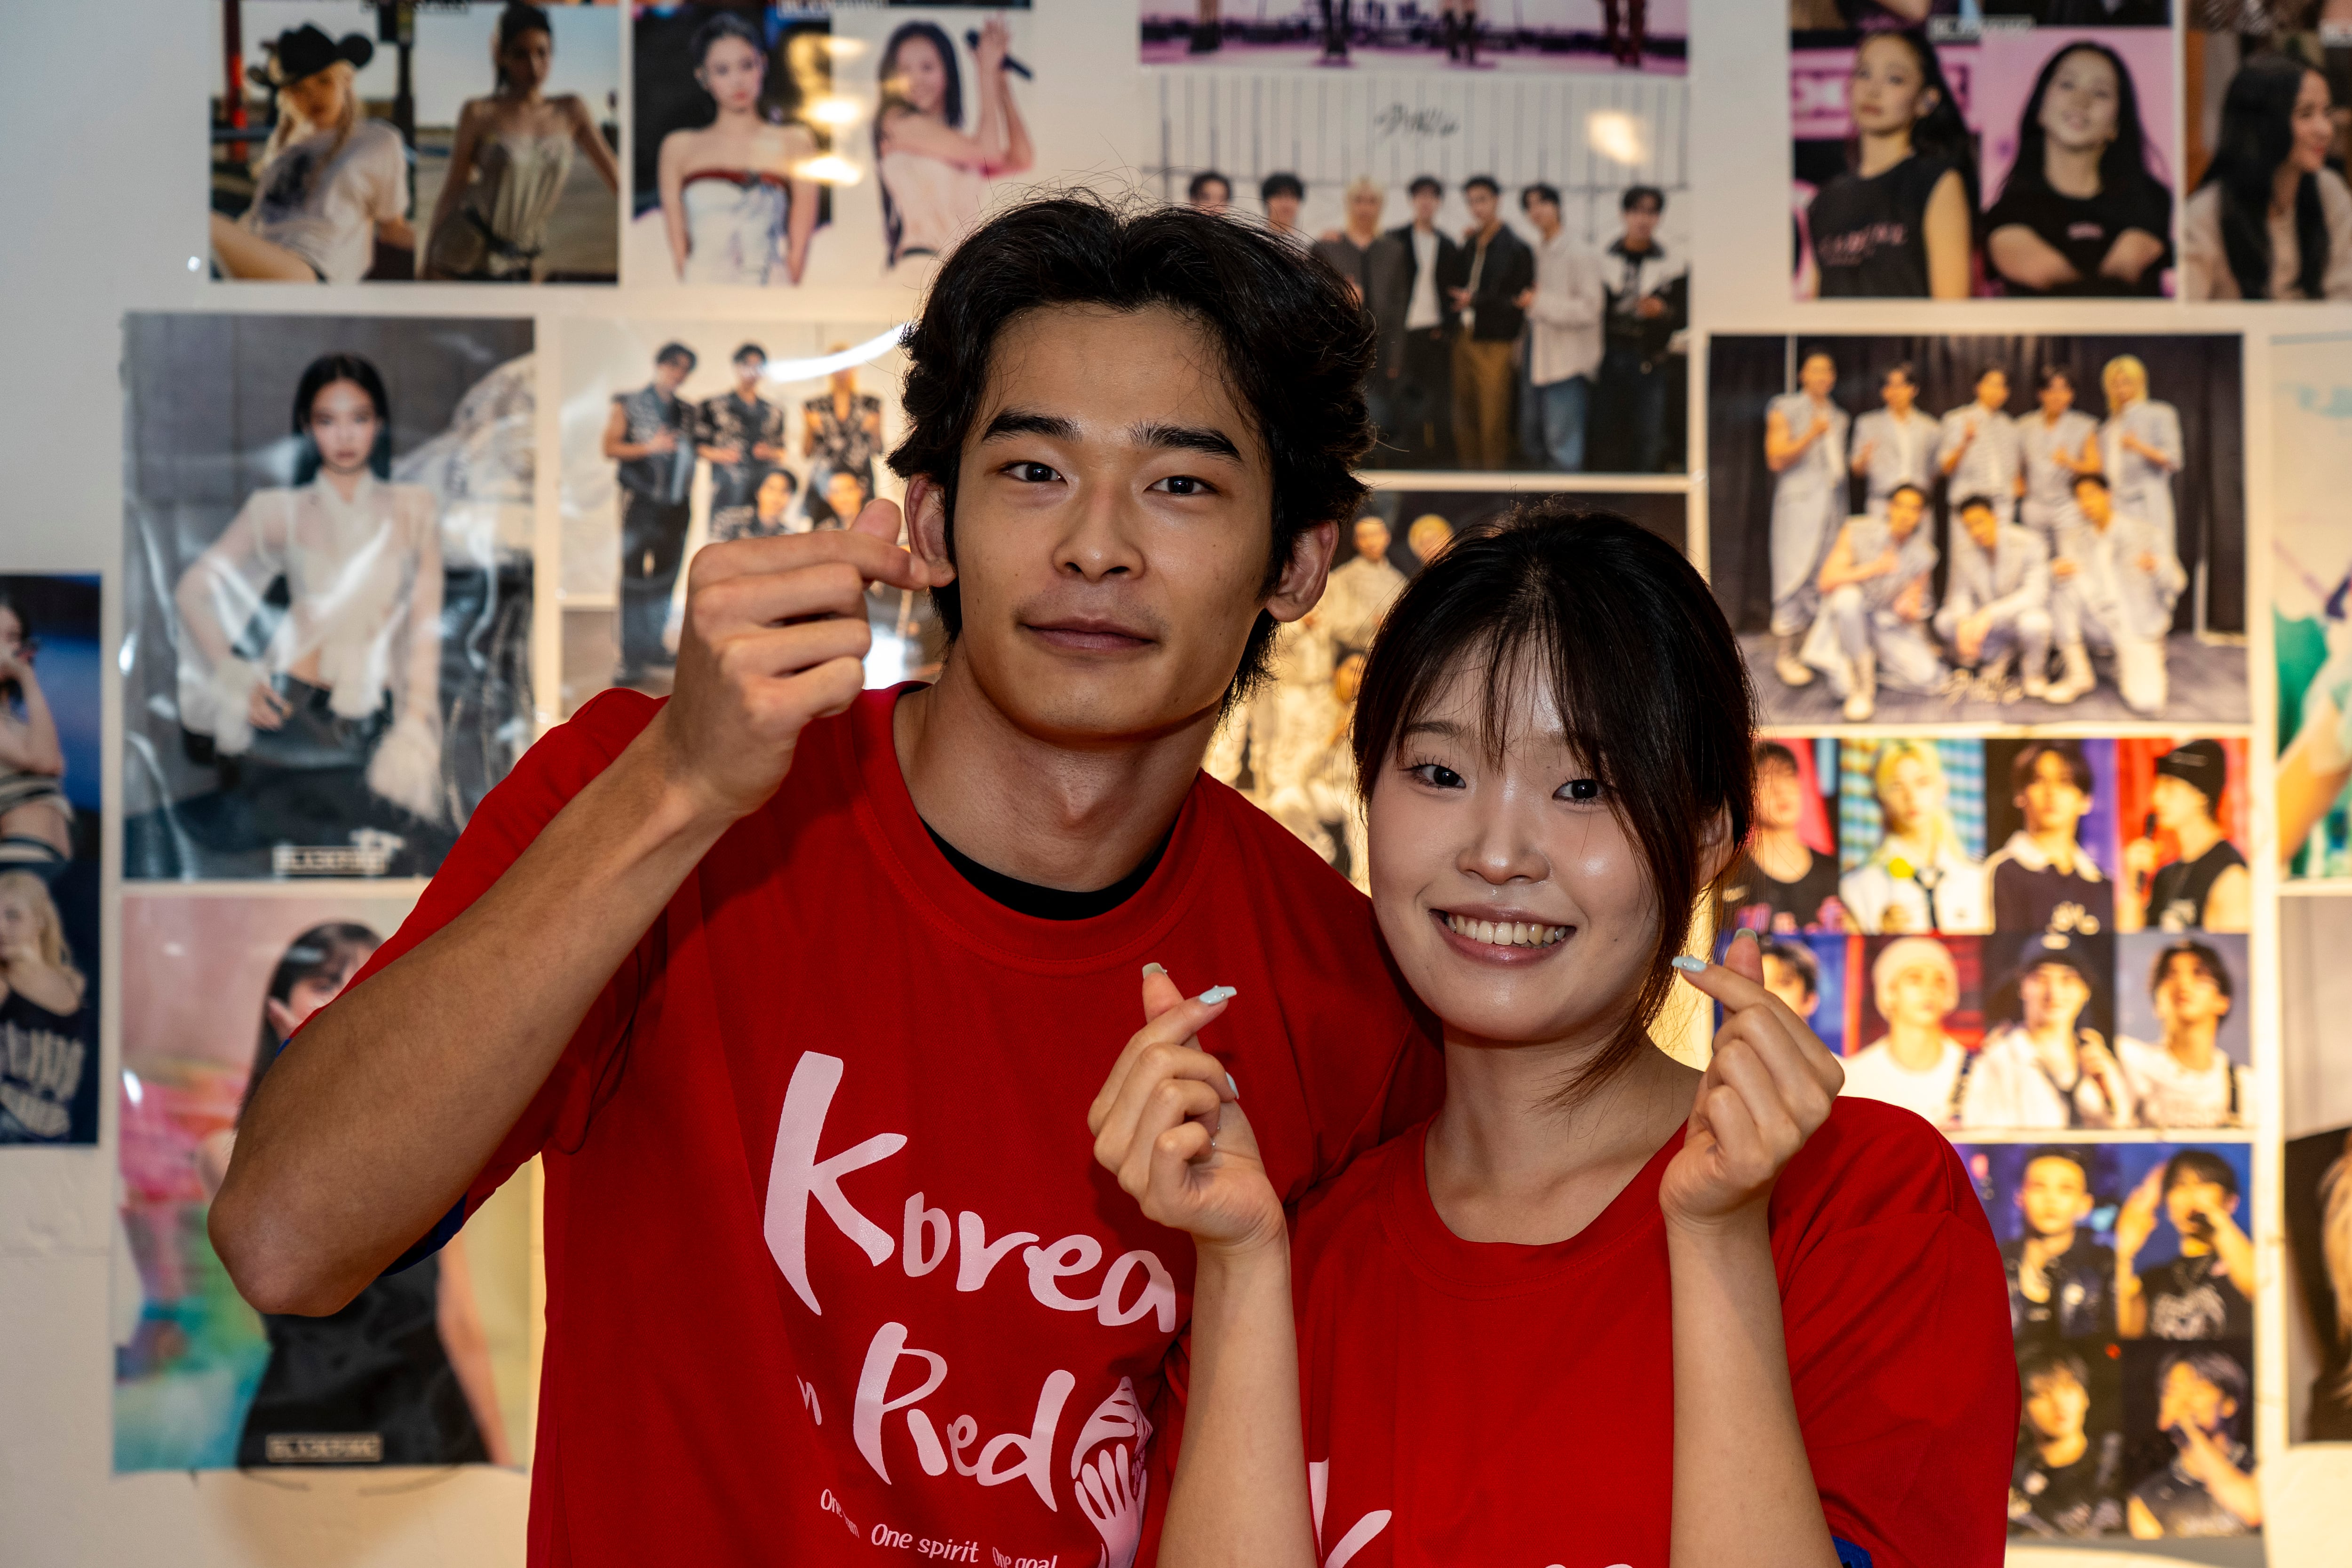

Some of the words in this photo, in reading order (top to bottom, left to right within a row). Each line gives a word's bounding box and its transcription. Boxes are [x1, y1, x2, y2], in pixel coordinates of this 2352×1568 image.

[763, 1050, 1176, 1333] Korea
[853, 1321, 1076, 1512] Red
[820, 1488, 842, 1518] One
[871, 1523, 913, 1549] One
[917, 1538, 979, 1563] spirit
[992, 1546, 1012, 1568] One
